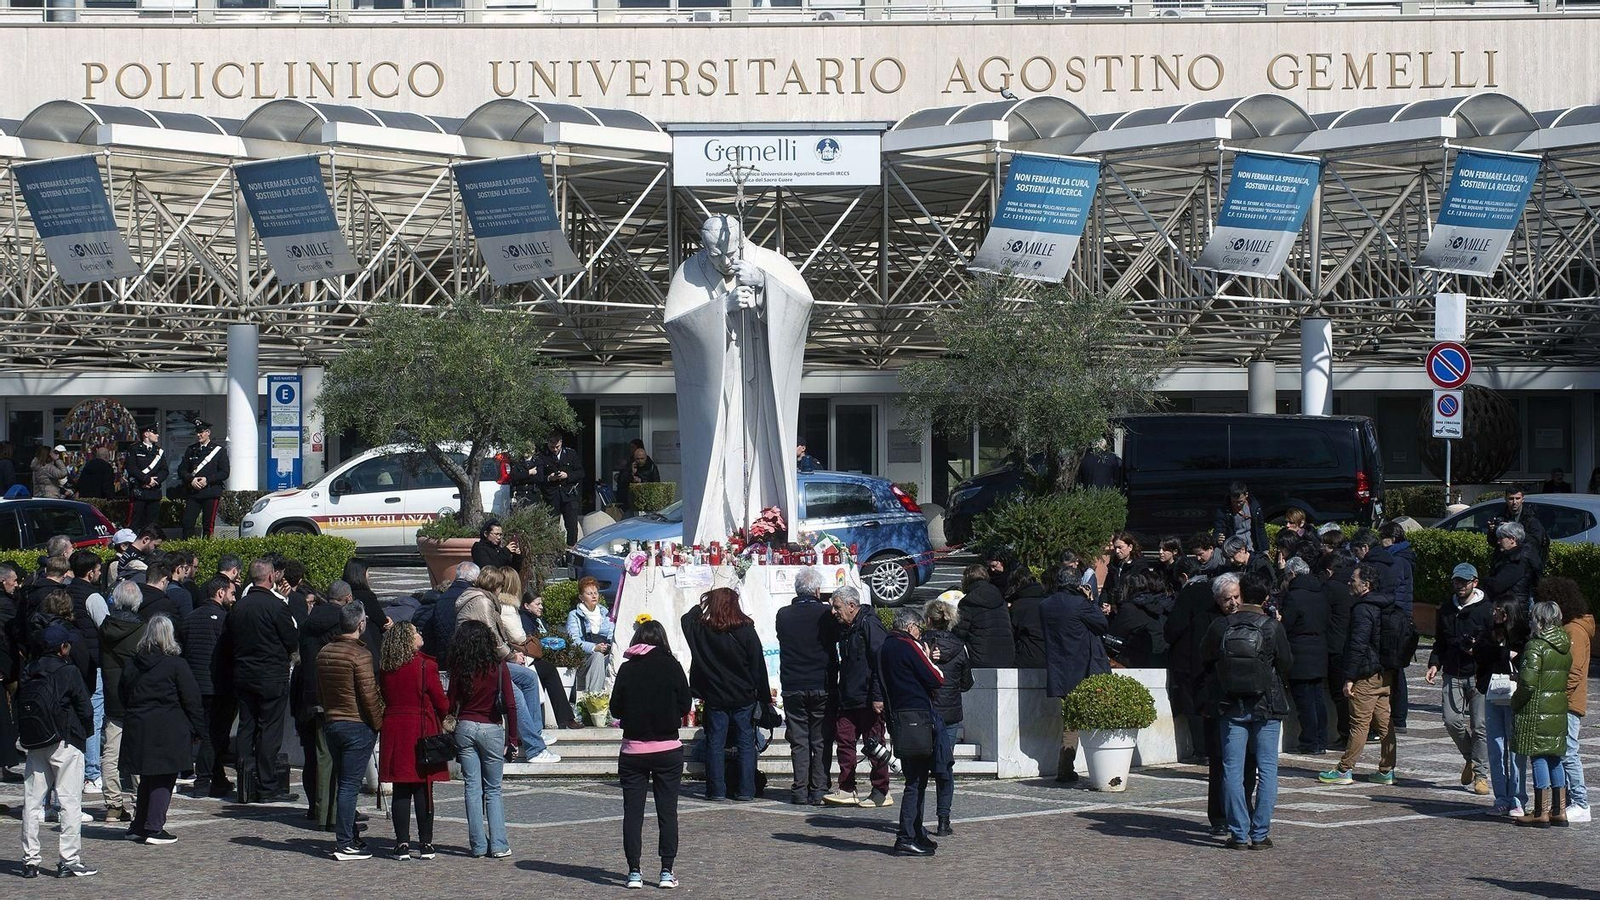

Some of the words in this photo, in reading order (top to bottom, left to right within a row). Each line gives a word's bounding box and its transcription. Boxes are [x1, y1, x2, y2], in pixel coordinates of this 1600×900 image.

[81, 61, 446, 100] POLICLINICO
[488, 56, 908, 98] UNIVERSITARIO
[941, 53, 1226, 94] AGOSTINO
[1266, 49, 1500, 91] GEMELLI
[704, 138, 796, 162] Gemelli
[248, 183, 264, 191] NON
[264, 179, 291, 189] FERMARE
[291, 178, 300, 186] LA
[300, 175, 319, 184] CURA,
[479, 180, 502, 189] FERMARE
[510, 176, 539, 186] SPERANZA,
[1014, 173, 1031, 181] NON
[1031, 174, 1061, 185] FERMARE
[1061, 178, 1069, 186] LA
[1071, 178, 1089, 188] CURA,
[1237, 171, 1251, 179] NON
[1251, 172, 1275, 181] FERMARE
[1282, 175, 1309, 186] SPERANZA,
[1459, 169, 1475, 177] NON
[1475, 170, 1502, 180] FERMARE
[1502, 173, 1511, 181] LA
[1511, 174, 1528, 184] CURA,
[255, 190, 282, 199] SOSTIENI
[283, 189, 292, 197] LA
[292, 186, 318, 195] RICERCA.
[477, 190, 500, 198] SOSTIENI
[509, 187, 531, 195] RICERCA.
[1016, 184, 1046, 193] SOSTIENI
[1046, 186, 1054, 194] LA
[1055, 188, 1083, 197] RICERCA.
[1244, 182, 1267, 191] SOSTIENI
[1268, 183, 1275, 191] LA
[1275, 185, 1297, 193] RICERCA.
[1460, 180, 1488, 189] SOSTIENI
[1488, 182, 1496, 190] LA
[1496, 183, 1521, 192] RICERCA.
[1223, 255, 1250, 265] Gemelli
[282, 389, 288, 400] E
[329, 516, 362, 527] URBE
[364, 514, 434, 526] VIGILANZA
[94, 524, 108, 535] 112
